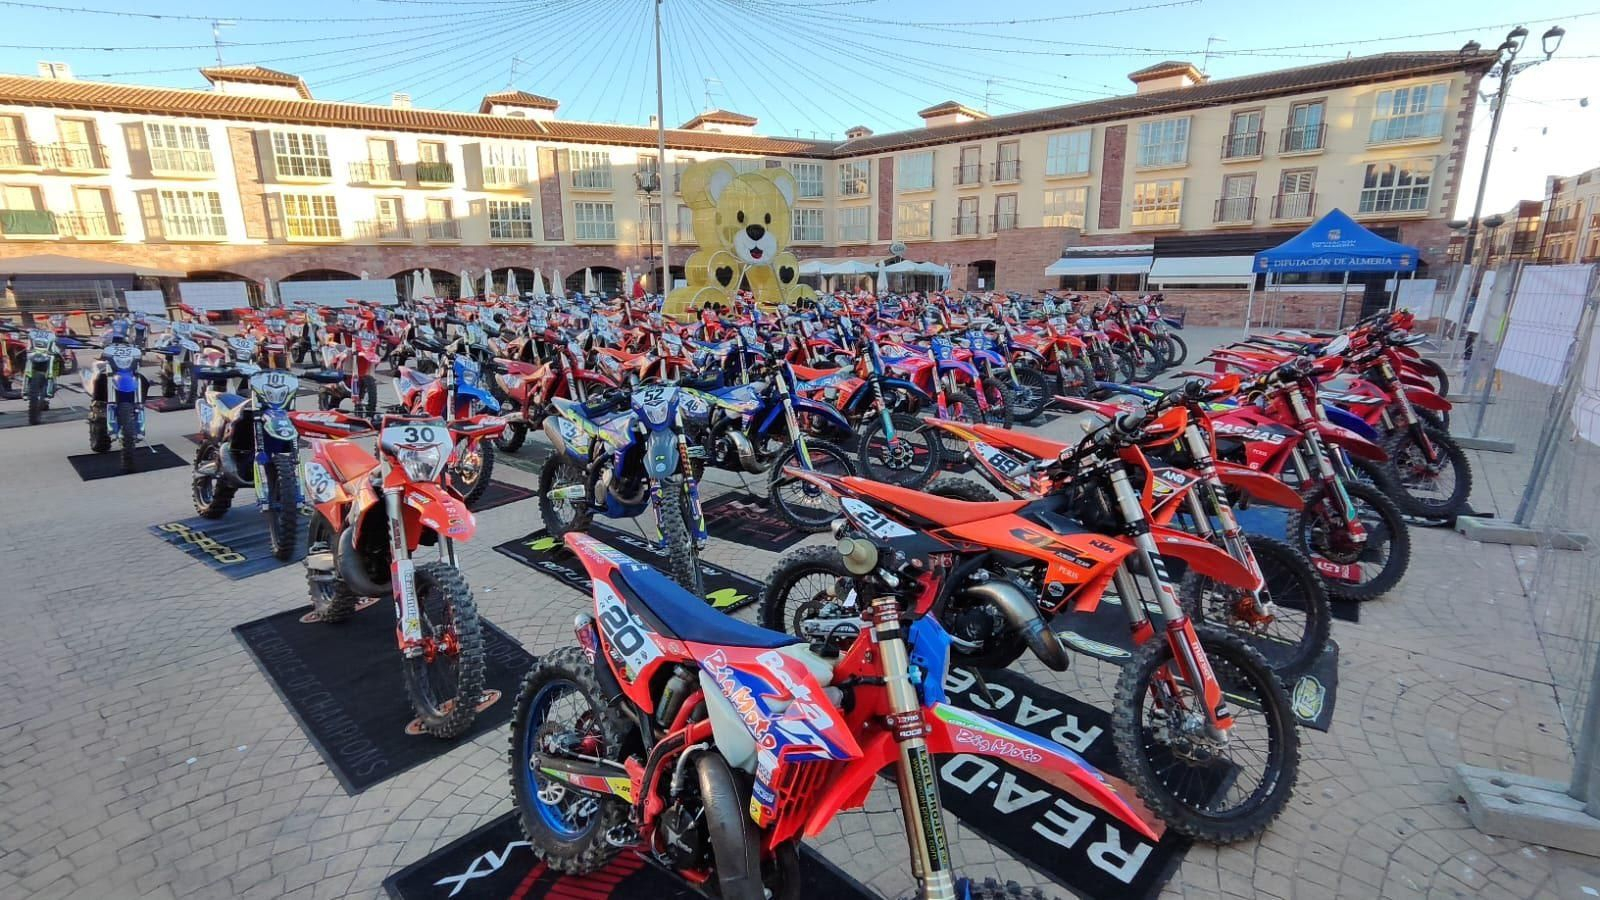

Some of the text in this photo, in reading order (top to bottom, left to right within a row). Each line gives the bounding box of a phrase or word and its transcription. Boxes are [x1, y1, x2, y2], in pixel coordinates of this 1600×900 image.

[1273, 256, 1393, 268] DIPUTACIÓN DE ALMERÍA
[266, 374, 286, 385] 101
[643, 387, 665, 402] 52
[404, 426, 435, 443] 30
[1211, 420, 1287, 445] GASGAS
[987, 453, 1022, 475] 89
[309, 472, 329, 495] 30
[858, 510, 890, 532] 21
[1088, 539, 1117, 554] KTM
[598, 604, 645, 657] 20
[755, 651, 834, 731] Beta
[945, 667, 1104, 753] RACE
[919, 749, 934, 790] EXCEL
